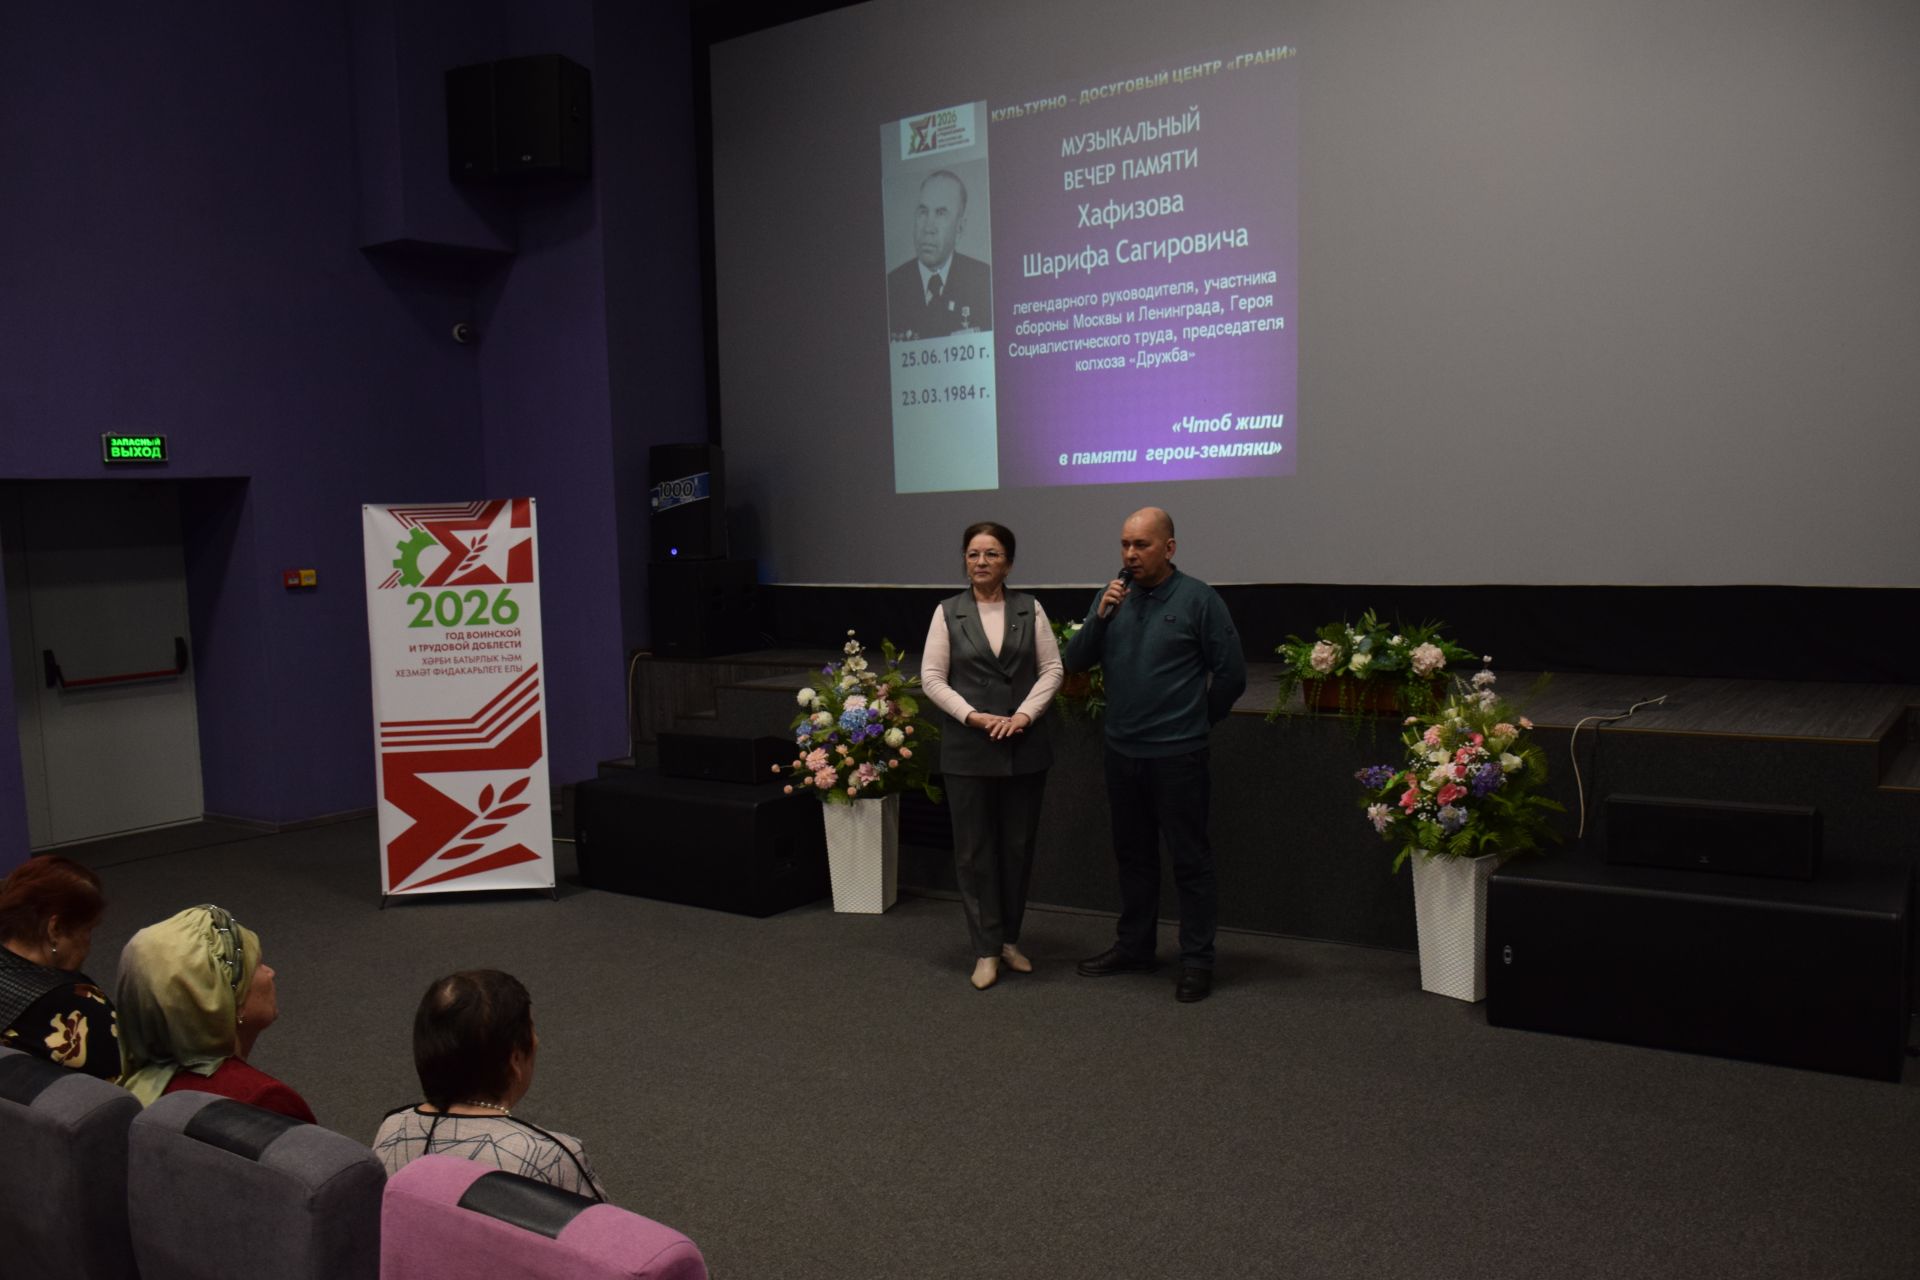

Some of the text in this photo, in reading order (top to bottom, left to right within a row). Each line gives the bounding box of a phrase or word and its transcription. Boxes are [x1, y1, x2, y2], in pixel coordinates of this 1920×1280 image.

[991, 94, 1067, 123] КУЛЬТУРНО
[1079, 70, 1169, 106] ДОСУГОВЫЙ
[1172, 59, 1222, 84] ЦЕНТР
[1227, 45, 1297, 71] «ГРАНИ»
[1061, 105, 1201, 158] МУЗЫКАЛЬНЫЙ
[1063, 147, 1199, 191] ВЕЧЕР ПАМЯТИ
[1077, 192, 1185, 230] Хафизова
[1022, 226, 1250, 280] Шарифа Сагировича
[1012, 269, 1278, 316] легендарного руководителя, участника
[1015, 294, 1274, 337] обороны Москвы и Ленинграда, Героя
[1008, 315, 1285, 359] Социалистического труда, председателя
[901, 345, 990, 368] 25.06.1920 г.
[1074, 347, 1196, 373] колхоза «Дружба»
[901, 385, 991, 407] 23.03.1984 г.
[1172, 412, 1284, 434] «Чтоб жили
[111, 437, 161, 446] ЗАПАСНЫЙ
[111, 447, 162, 459] ВЫХОД
[1059, 440, 1283, 467] в памяти герои-земляки»
[659, 481, 695, 498] 1000
[406, 588, 520, 628] 2026
[409, 640, 522, 654] И ТРУДОВОЙ ДОБЛЕСТИ
[445, 627, 521, 641] ГОД ВОИНСКОЙ
[395, 668, 431, 678] ХЕЗМӘТ
[504, 664, 523, 673] ЕЛЫ
[422, 656, 451, 666] ХӘРБИ
[453, 654, 499, 665] БАТЫРЛЫК
